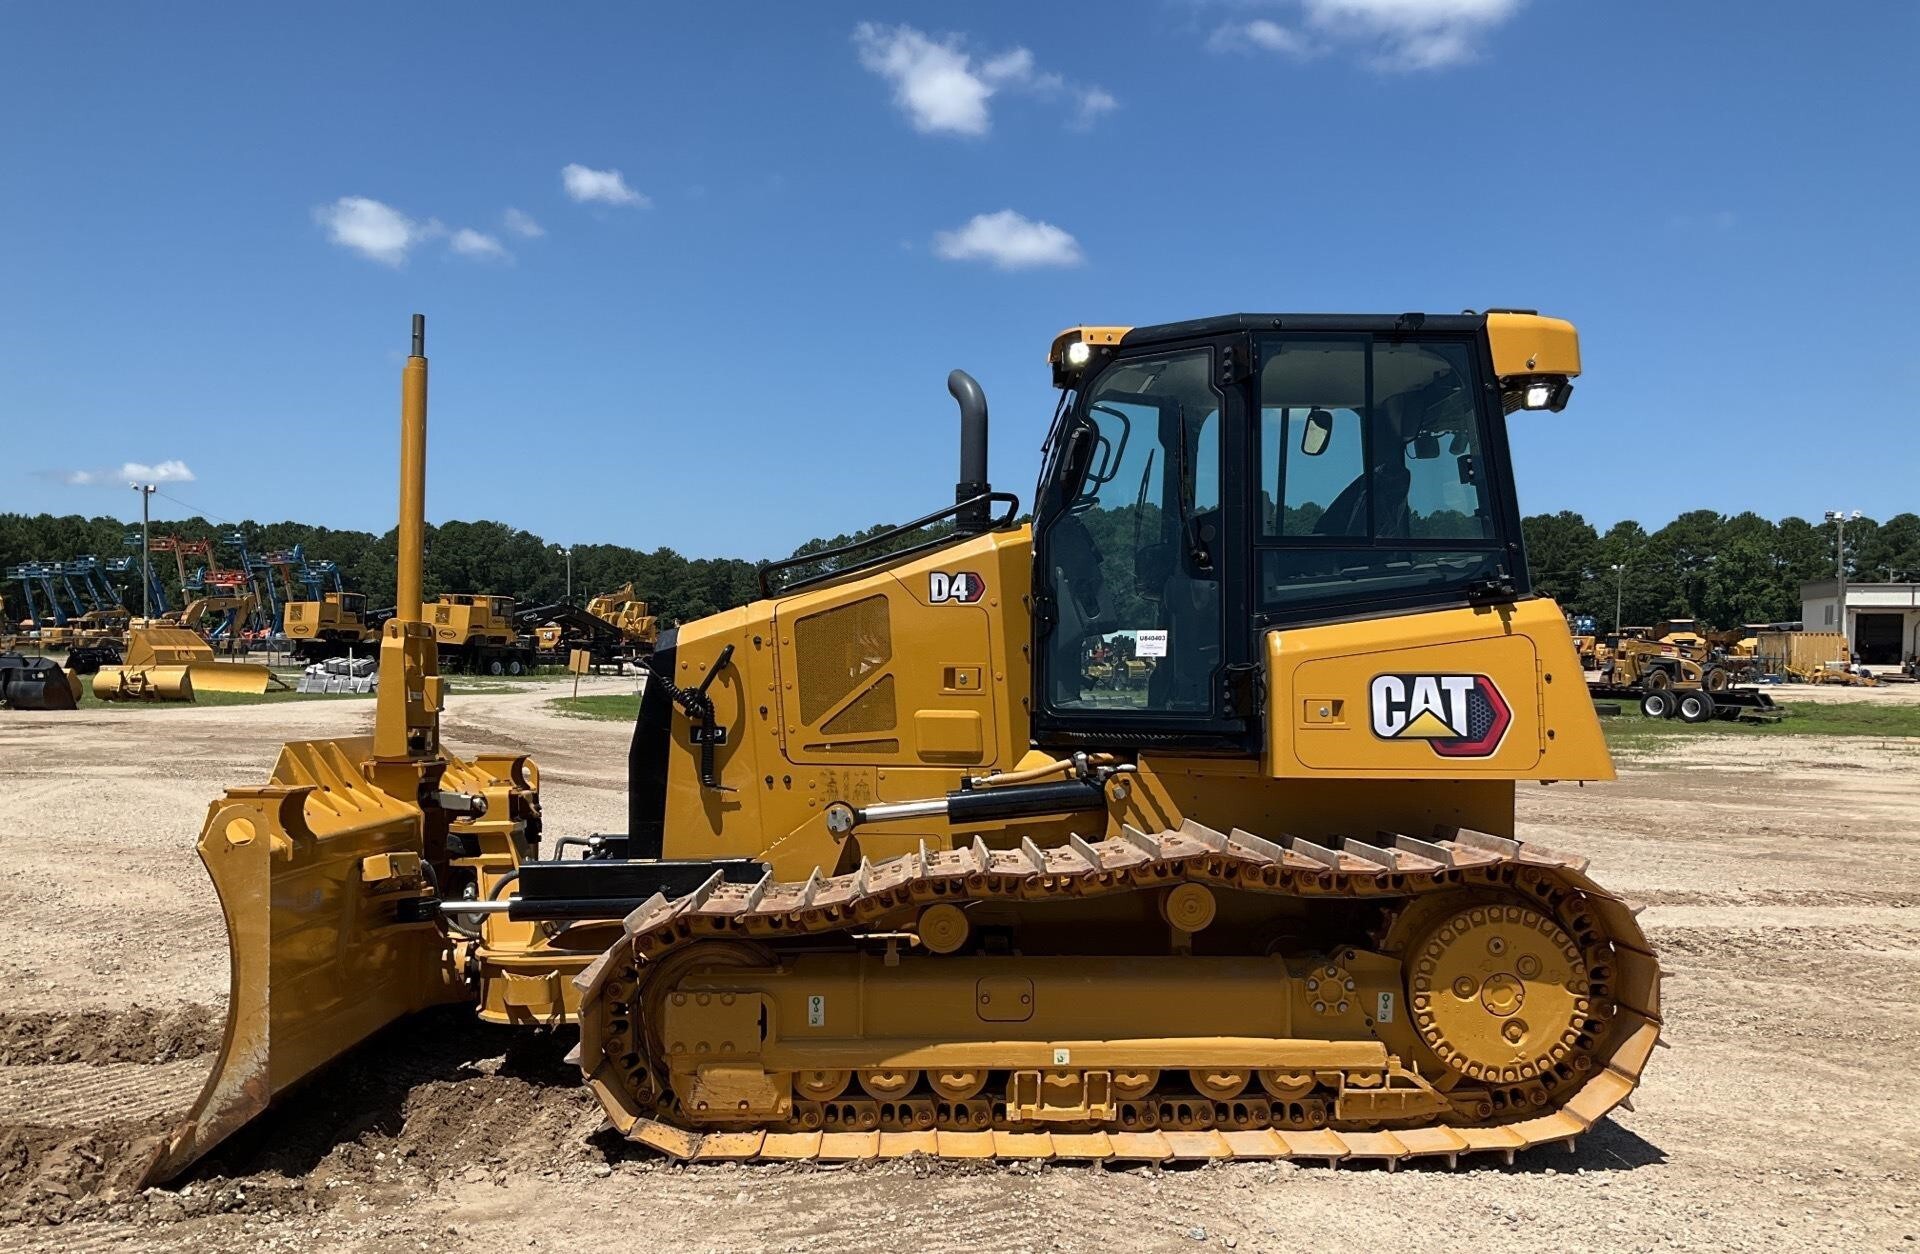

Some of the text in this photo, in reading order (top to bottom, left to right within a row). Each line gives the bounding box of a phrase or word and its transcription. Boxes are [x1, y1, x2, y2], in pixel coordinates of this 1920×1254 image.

[930, 573, 968, 601] D4
[1372, 676, 1474, 737] CAT
[696, 729, 722, 741] LP
